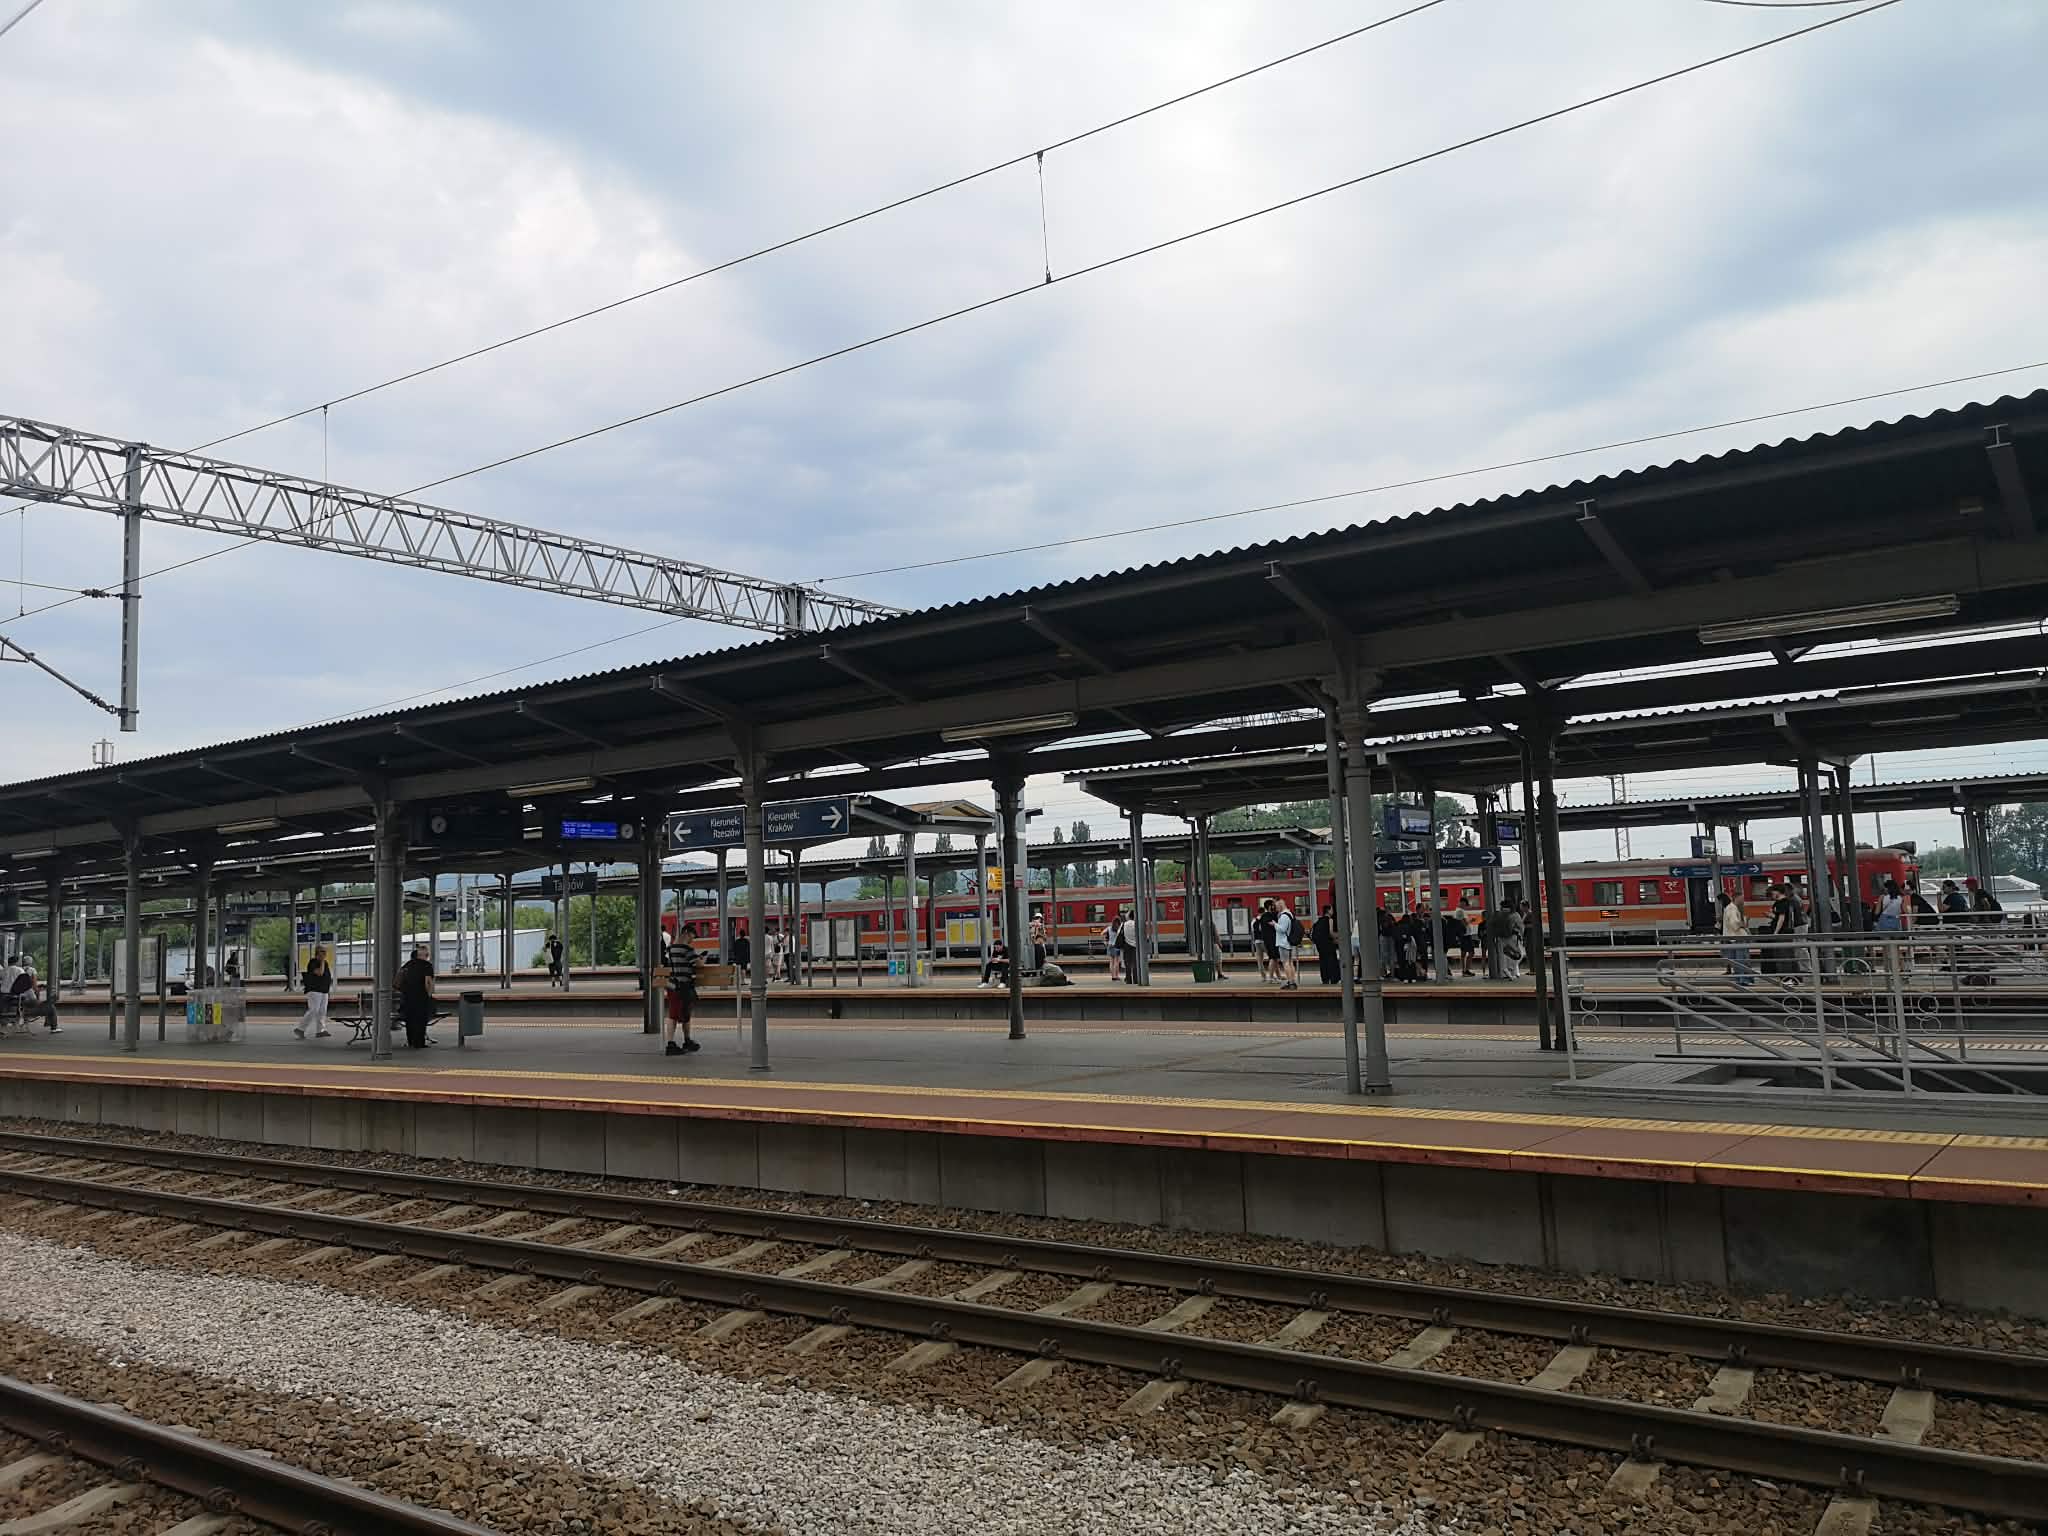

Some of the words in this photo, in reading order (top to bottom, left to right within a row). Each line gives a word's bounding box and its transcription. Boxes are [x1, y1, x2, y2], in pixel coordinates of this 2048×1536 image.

[768, 810, 800, 821] Kierunek:
[713, 828, 741, 838] Rzeszów
[768, 823, 794, 833] Kraków
